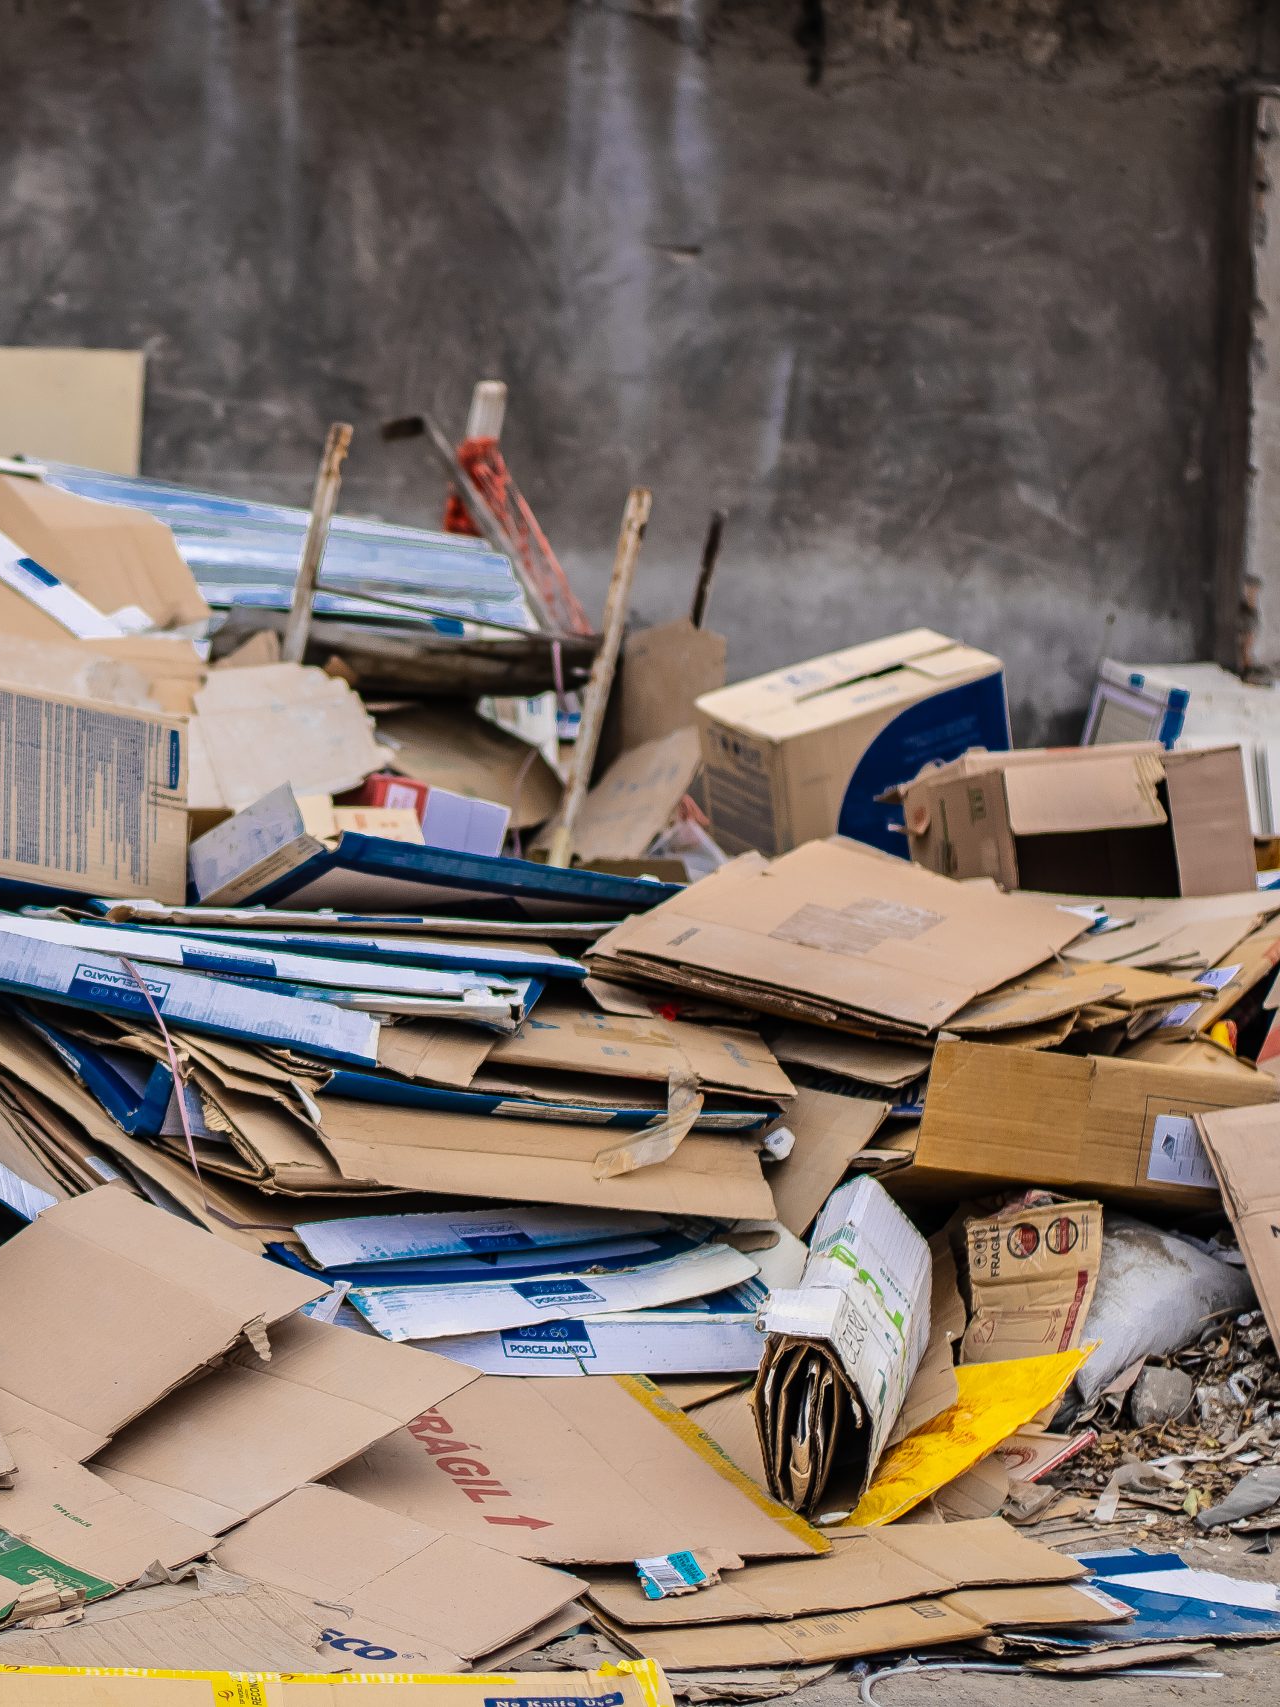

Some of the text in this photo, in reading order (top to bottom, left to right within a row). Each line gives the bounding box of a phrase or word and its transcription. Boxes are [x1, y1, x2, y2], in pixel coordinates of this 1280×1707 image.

[990, 1224, 1001, 1278] FRAGILE
[520, 1327, 537, 1337] 60
[549, 1327, 568, 1338] 60
[510, 1344, 588, 1355] PORCELANATO
[407, 1408, 513, 1503] RÁGIL
